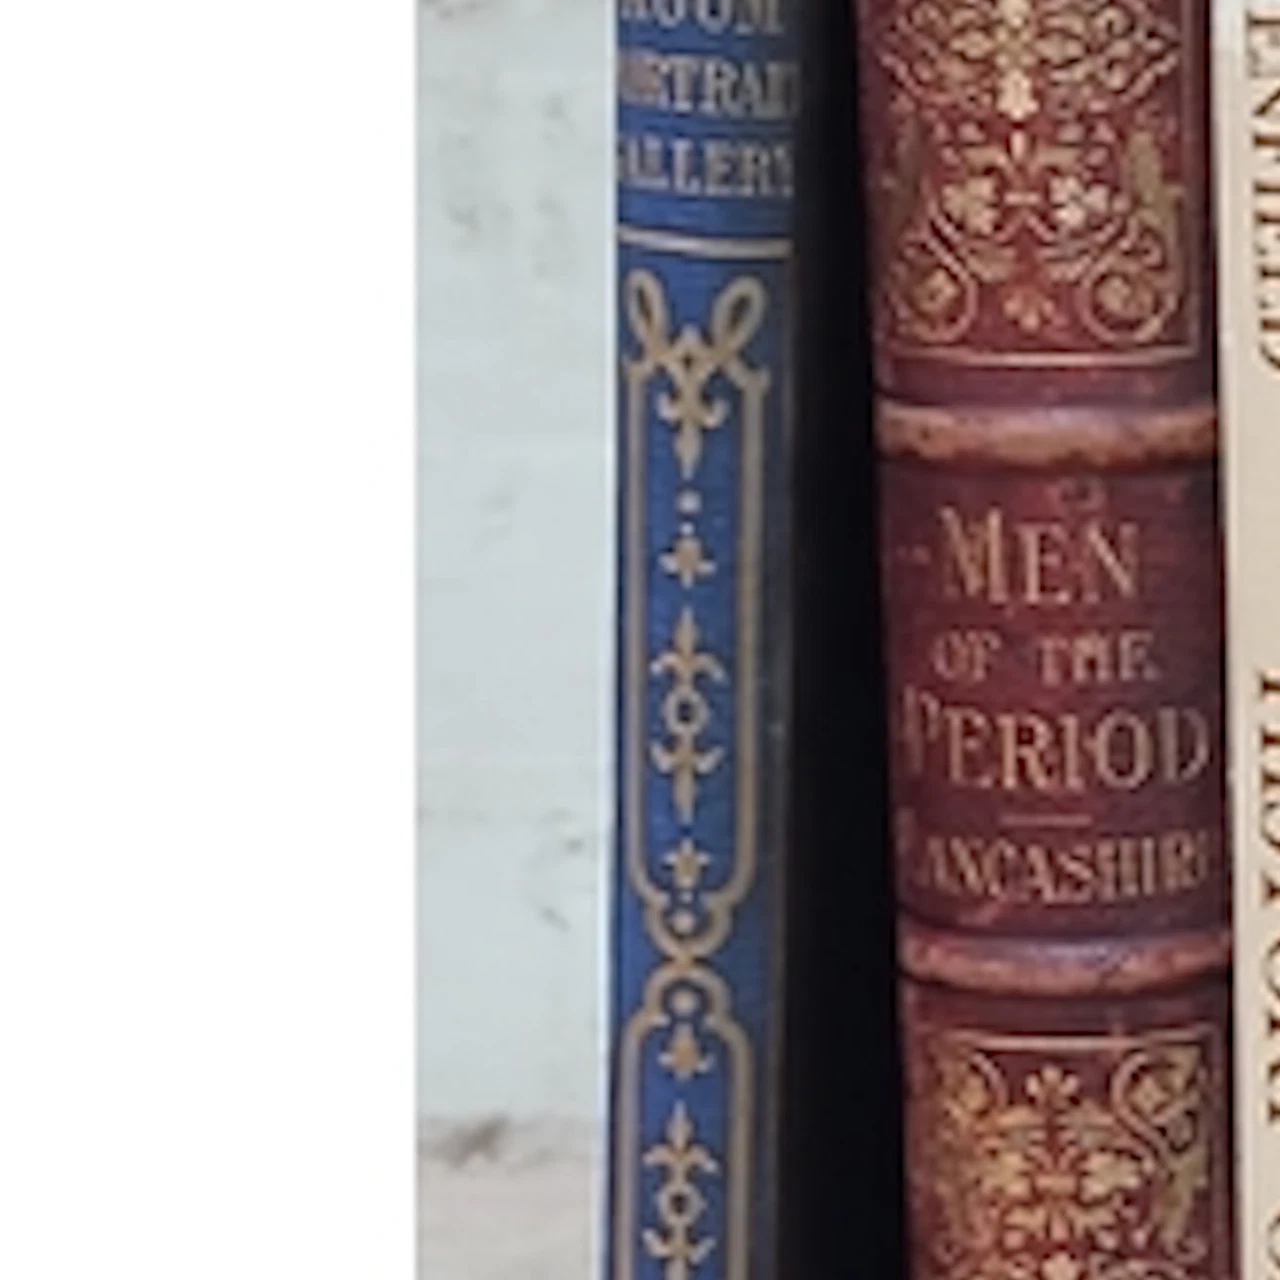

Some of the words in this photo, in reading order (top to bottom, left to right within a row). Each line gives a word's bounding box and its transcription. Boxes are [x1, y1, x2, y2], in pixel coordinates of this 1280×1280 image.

[937, 505, 1142, 606] MEN
[931, 630, 1001, 682] OF
[1036, 630, 1161, 687] THE
[901, 684, 1212, 793] PERIOD
